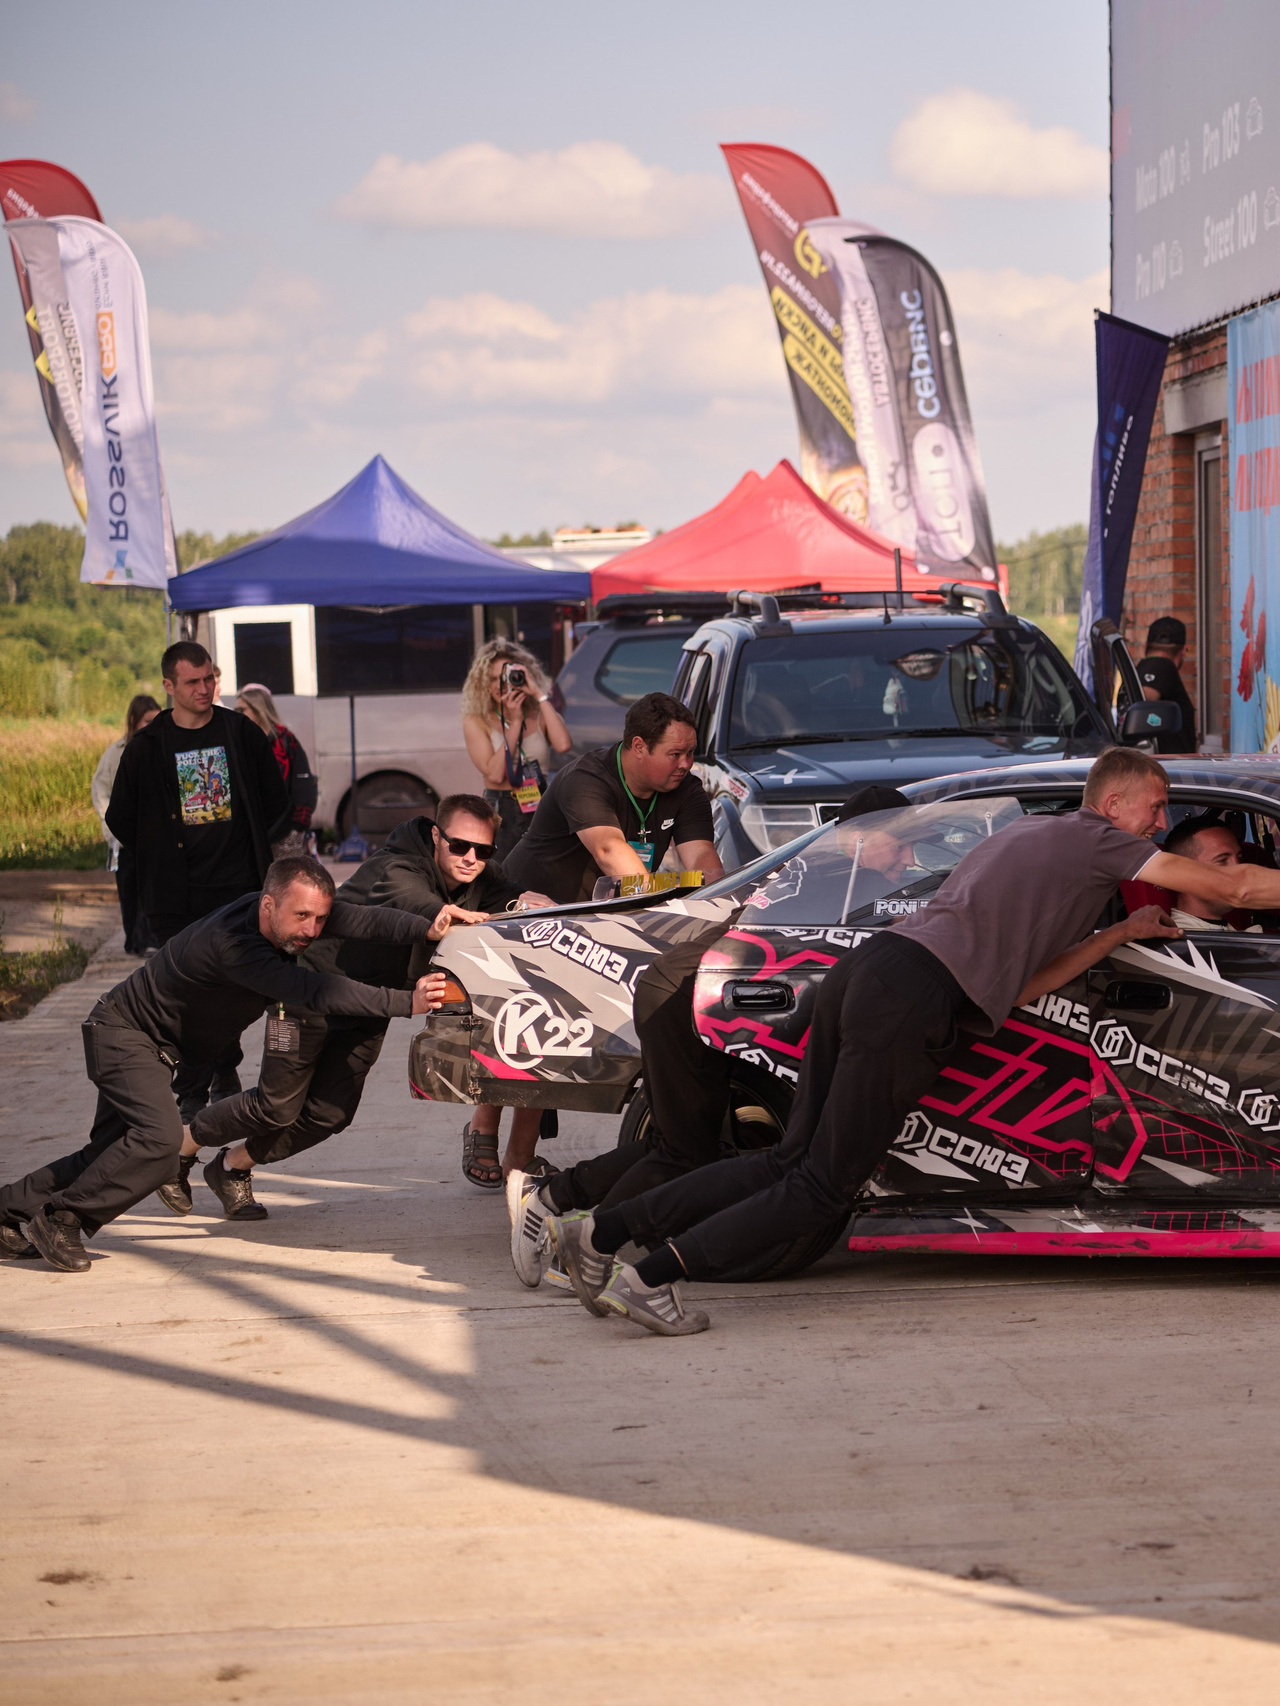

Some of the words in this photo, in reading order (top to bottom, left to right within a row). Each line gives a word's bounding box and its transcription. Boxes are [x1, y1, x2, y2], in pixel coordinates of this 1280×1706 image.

[1203, 122, 1220, 174] Pro
[1222, 102, 1240, 162] 103
[1159, 145, 1176, 199] 100
[1204, 207, 1235, 268] Street
[1238, 190, 1258, 250] 100
[176, 751, 199, 761] FUCK
[200, 748, 220, 757] THE
